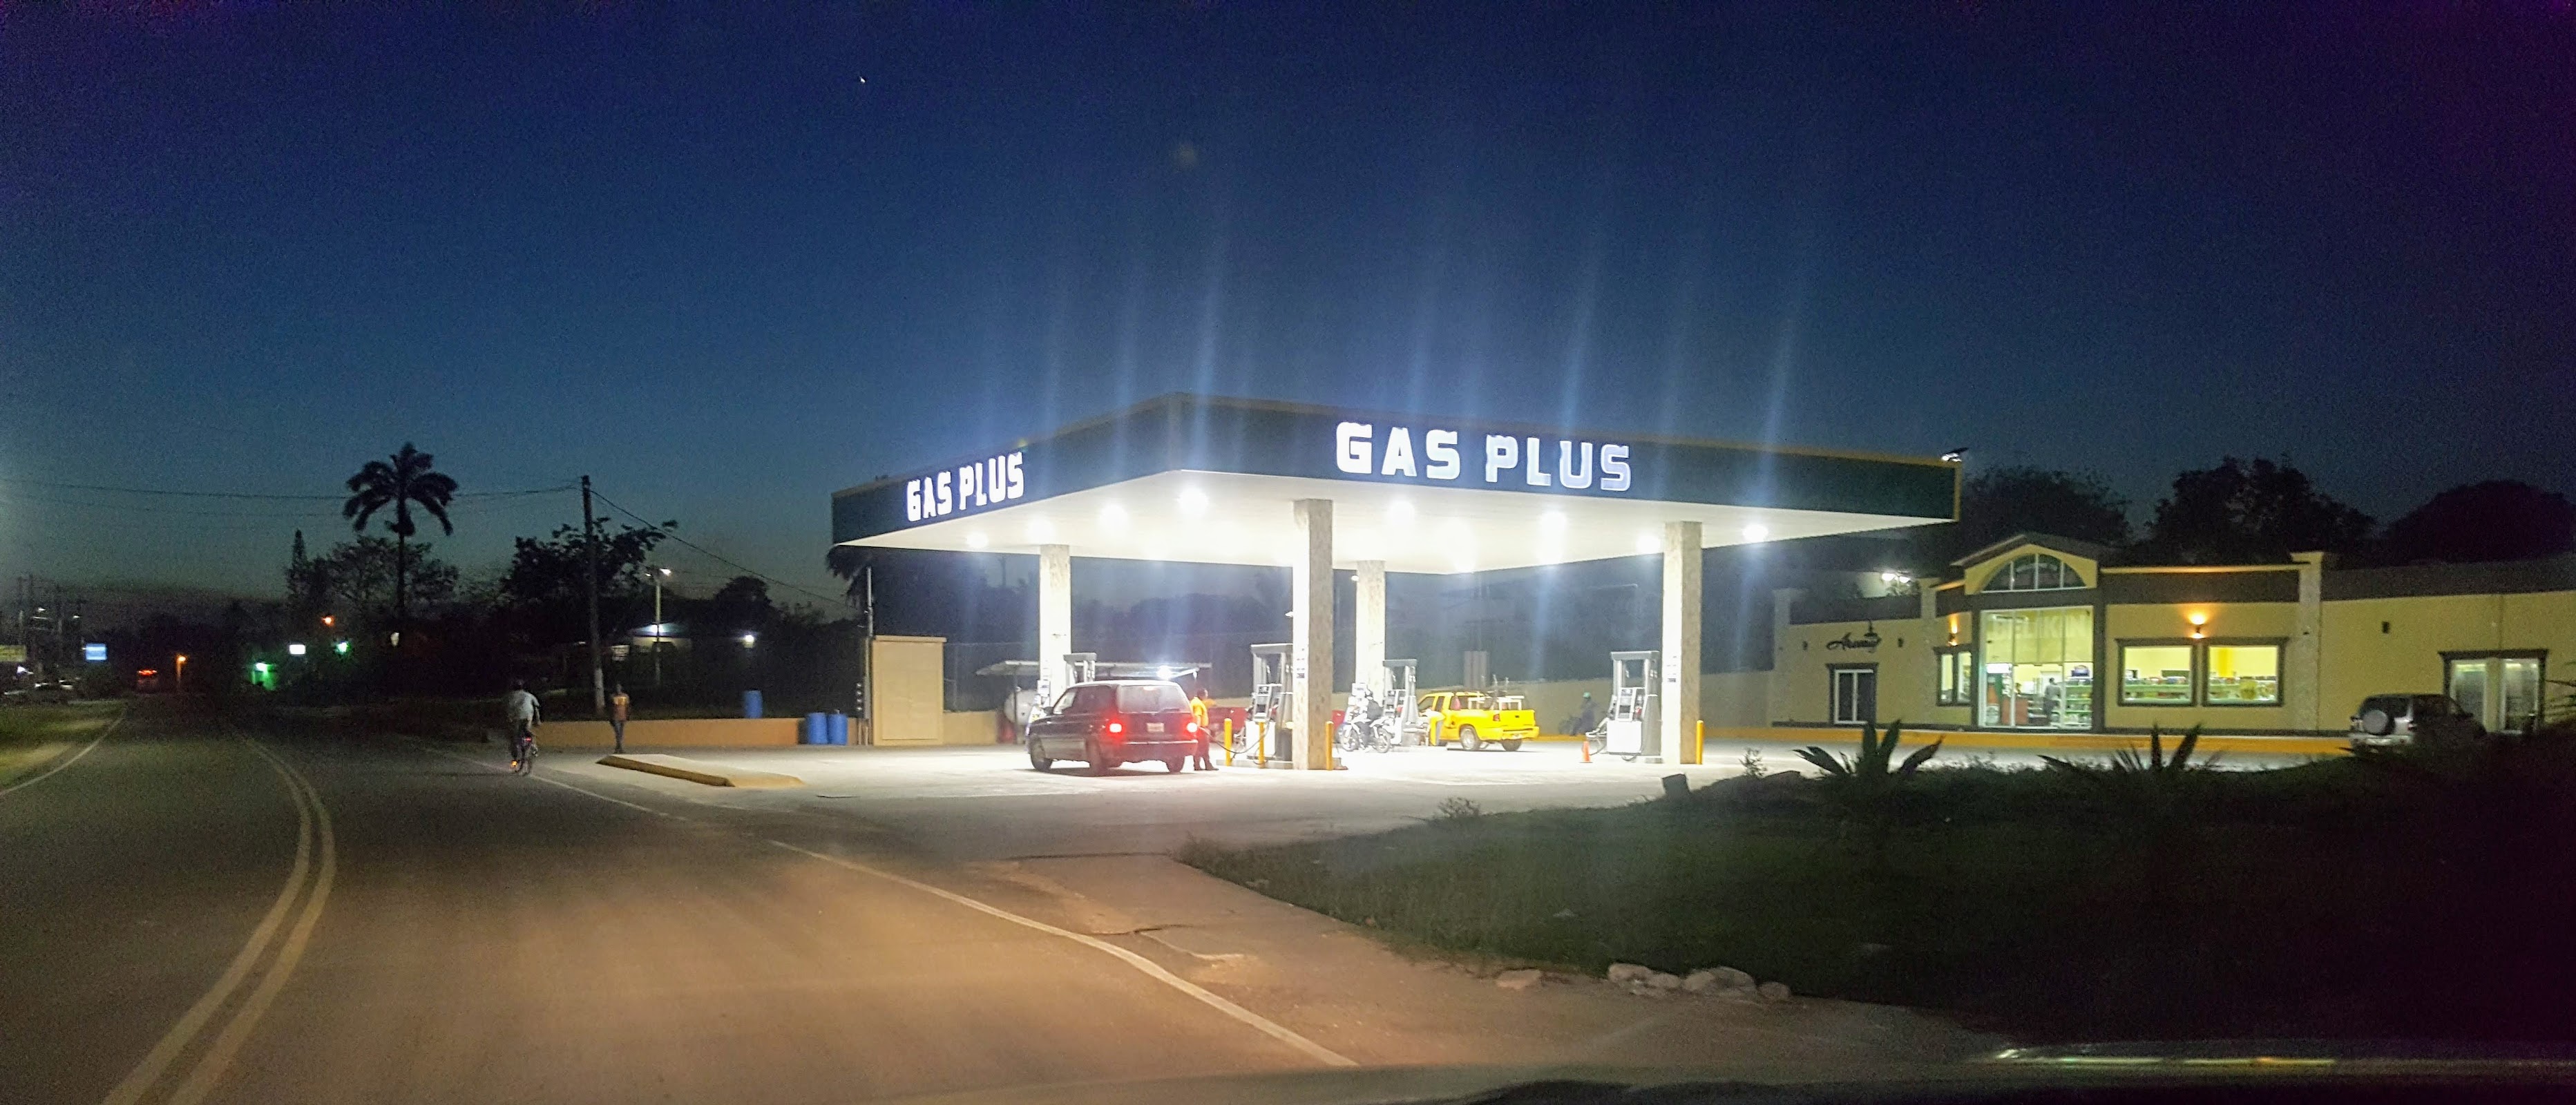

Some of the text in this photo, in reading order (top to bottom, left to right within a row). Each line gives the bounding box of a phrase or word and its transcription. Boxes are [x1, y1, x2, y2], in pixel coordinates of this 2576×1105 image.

[906, 452, 1024, 522] GAS PLUS
[1336, 421, 1632, 492] GAS PLUS
